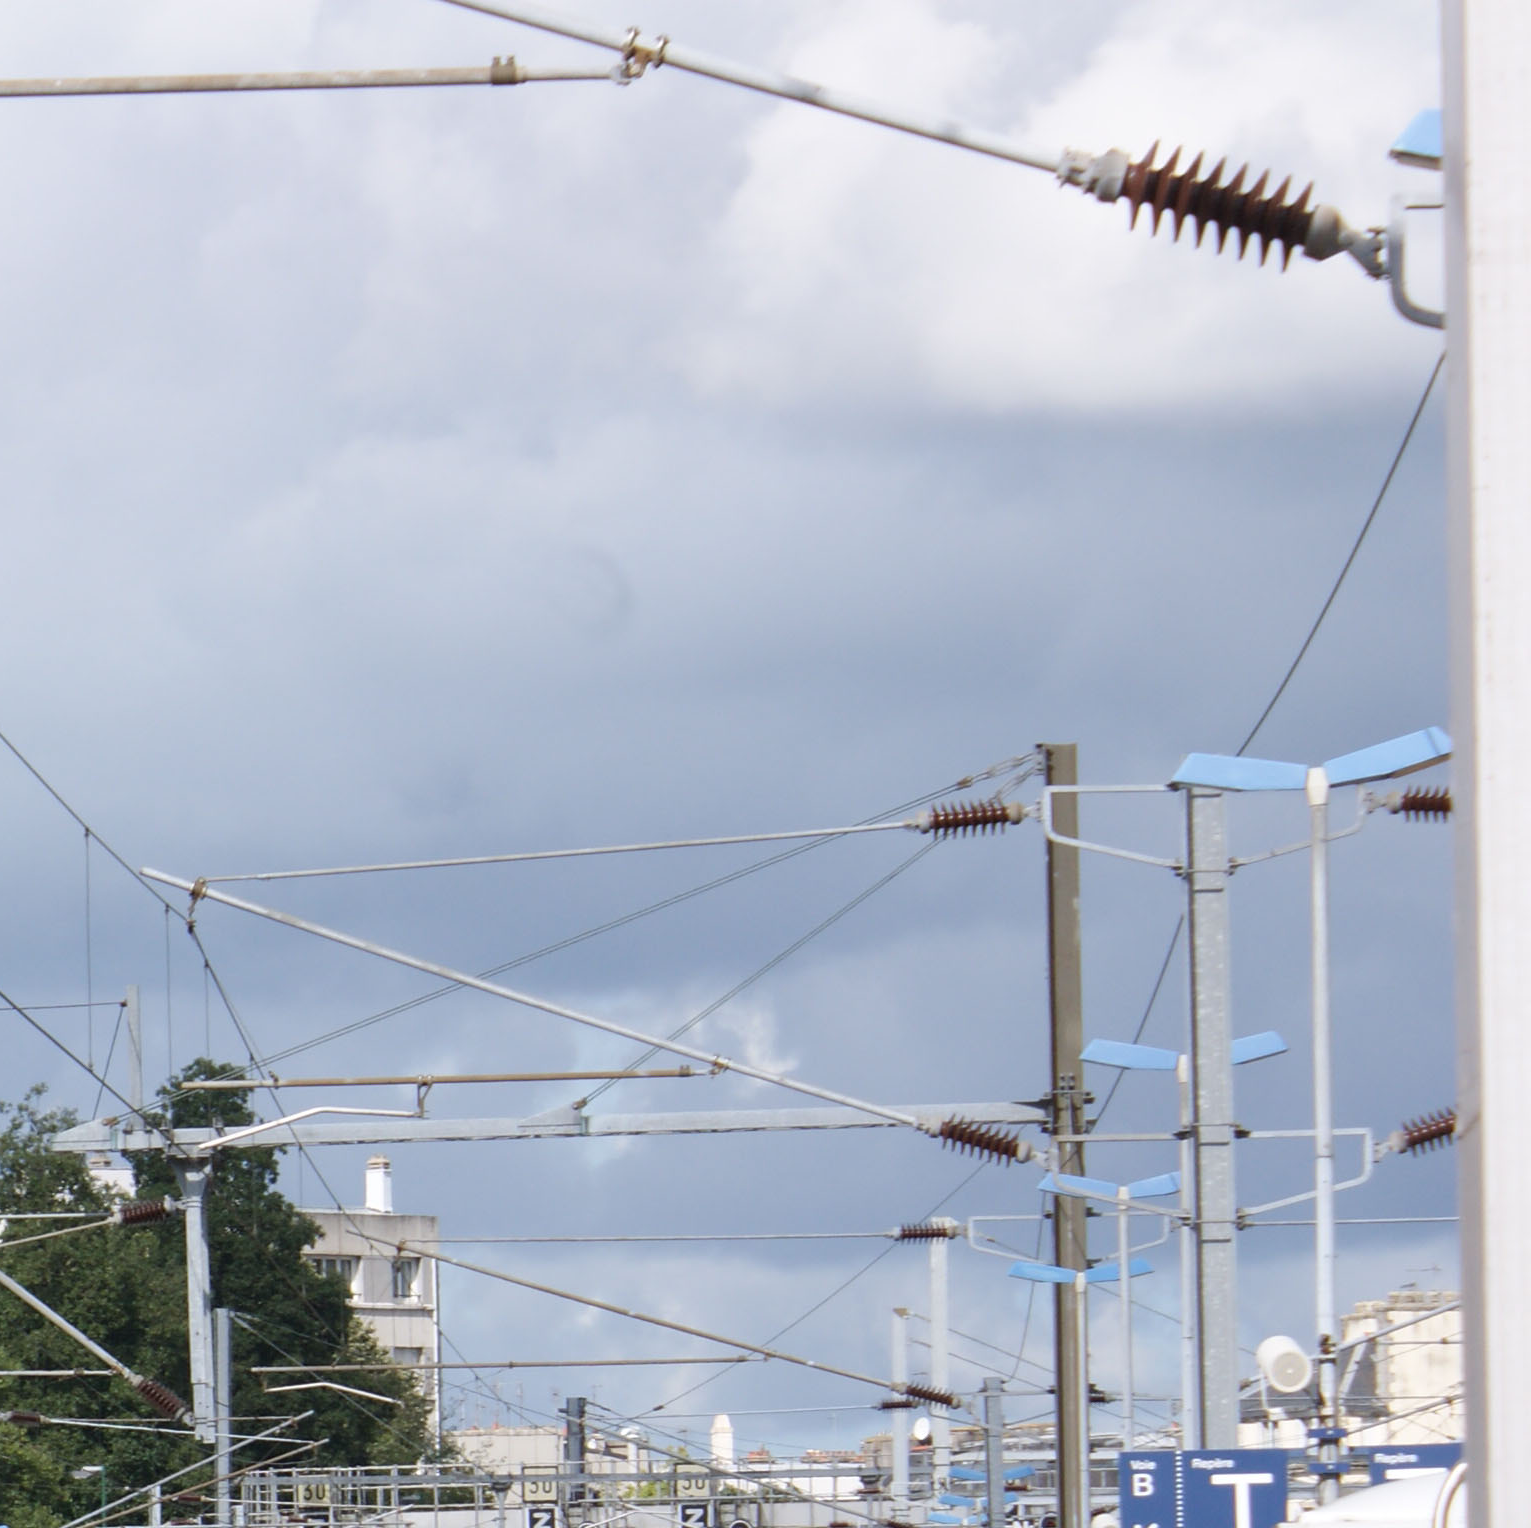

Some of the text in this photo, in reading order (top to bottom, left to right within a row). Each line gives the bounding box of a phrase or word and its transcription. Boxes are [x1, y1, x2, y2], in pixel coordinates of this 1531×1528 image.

[1129, 1459, 1157, 1471] Voie
[1190, 1458, 1235, 1471] Repère
[1132, 1473, 1155, 1497] B
[685, 1508, 705, 1528] Z
